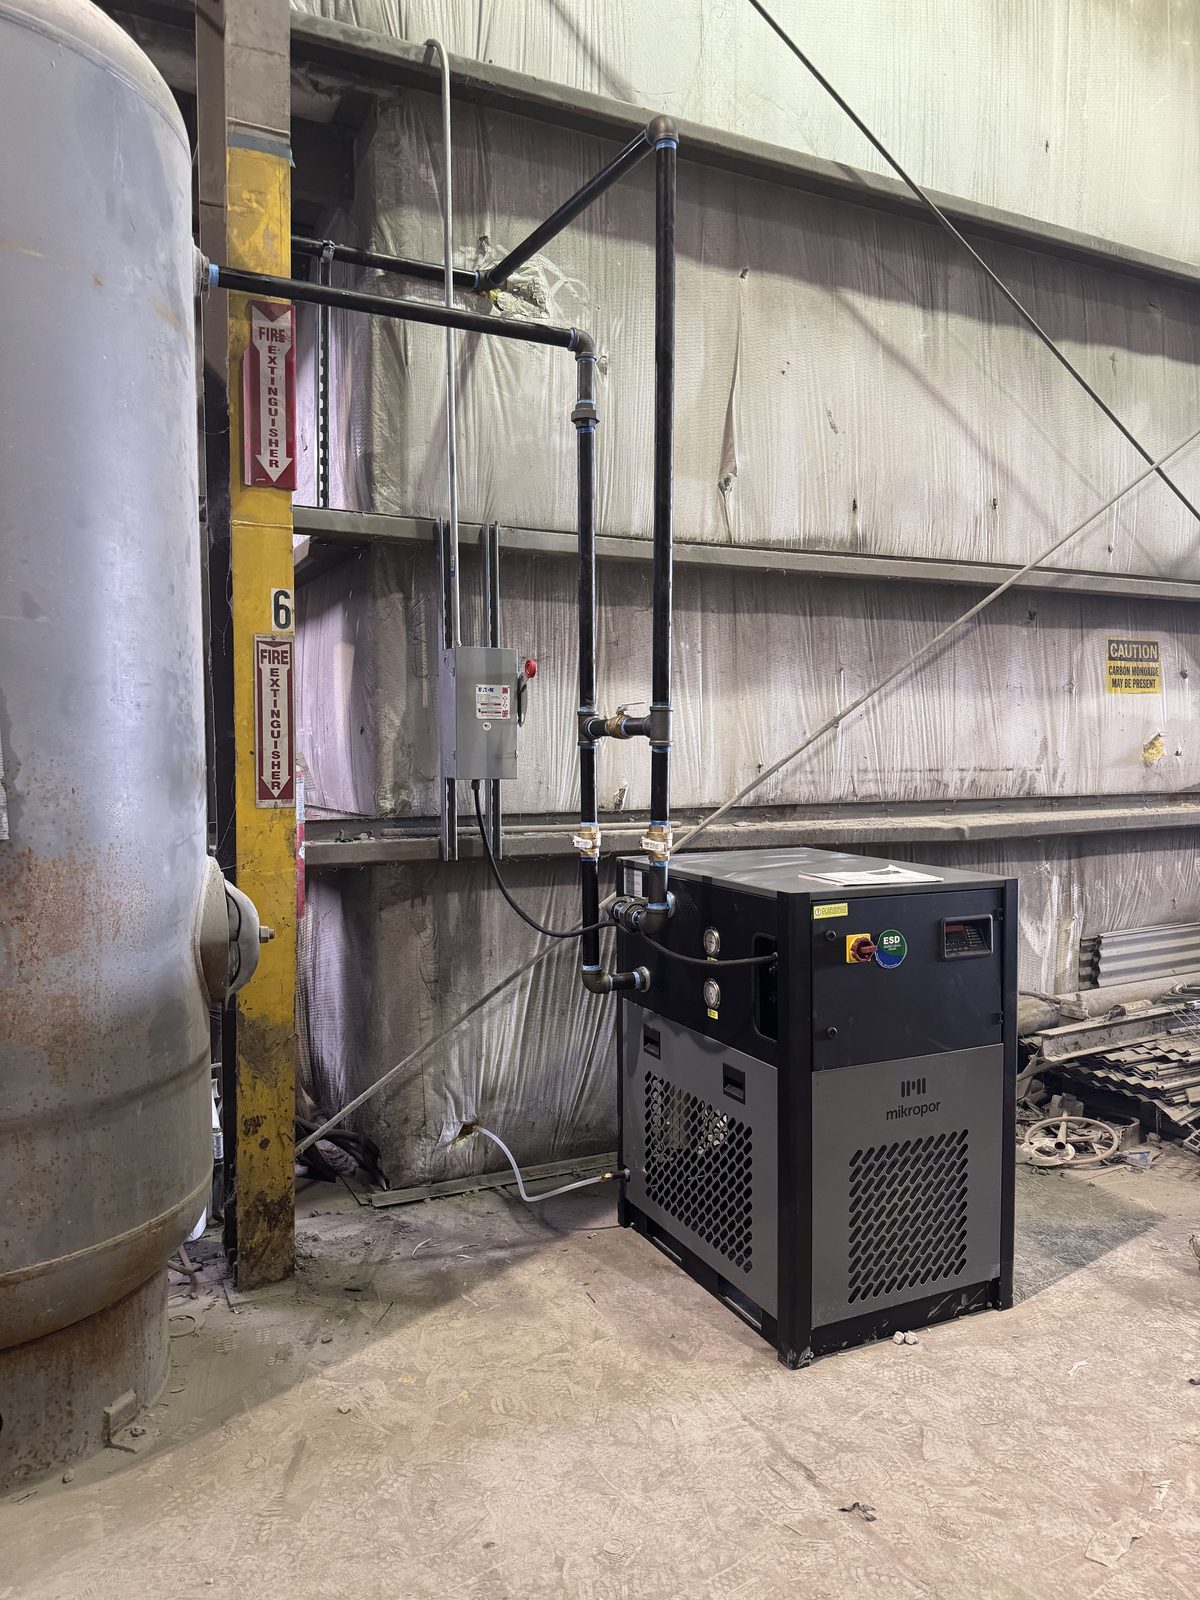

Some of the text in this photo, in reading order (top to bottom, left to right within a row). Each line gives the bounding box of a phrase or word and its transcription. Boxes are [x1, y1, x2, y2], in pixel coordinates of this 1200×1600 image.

[259, 326, 285, 342] FIRE
[267, 345, 280, 468] EXTINGUISHER
[273, 589, 291, 630] 6
[260, 649, 289, 665] FIRE
[1109, 642, 1158, 659] CAUTION
[1108, 665, 1159, 677] CARBON MONOXIDE
[1111, 678, 1156, 689] MAY BE PRESENT
[269, 667, 281, 790] EXTINGUISHER
[883, 935, 900, 945] ESD
[886, 1101, 941, 1121] mikropor
